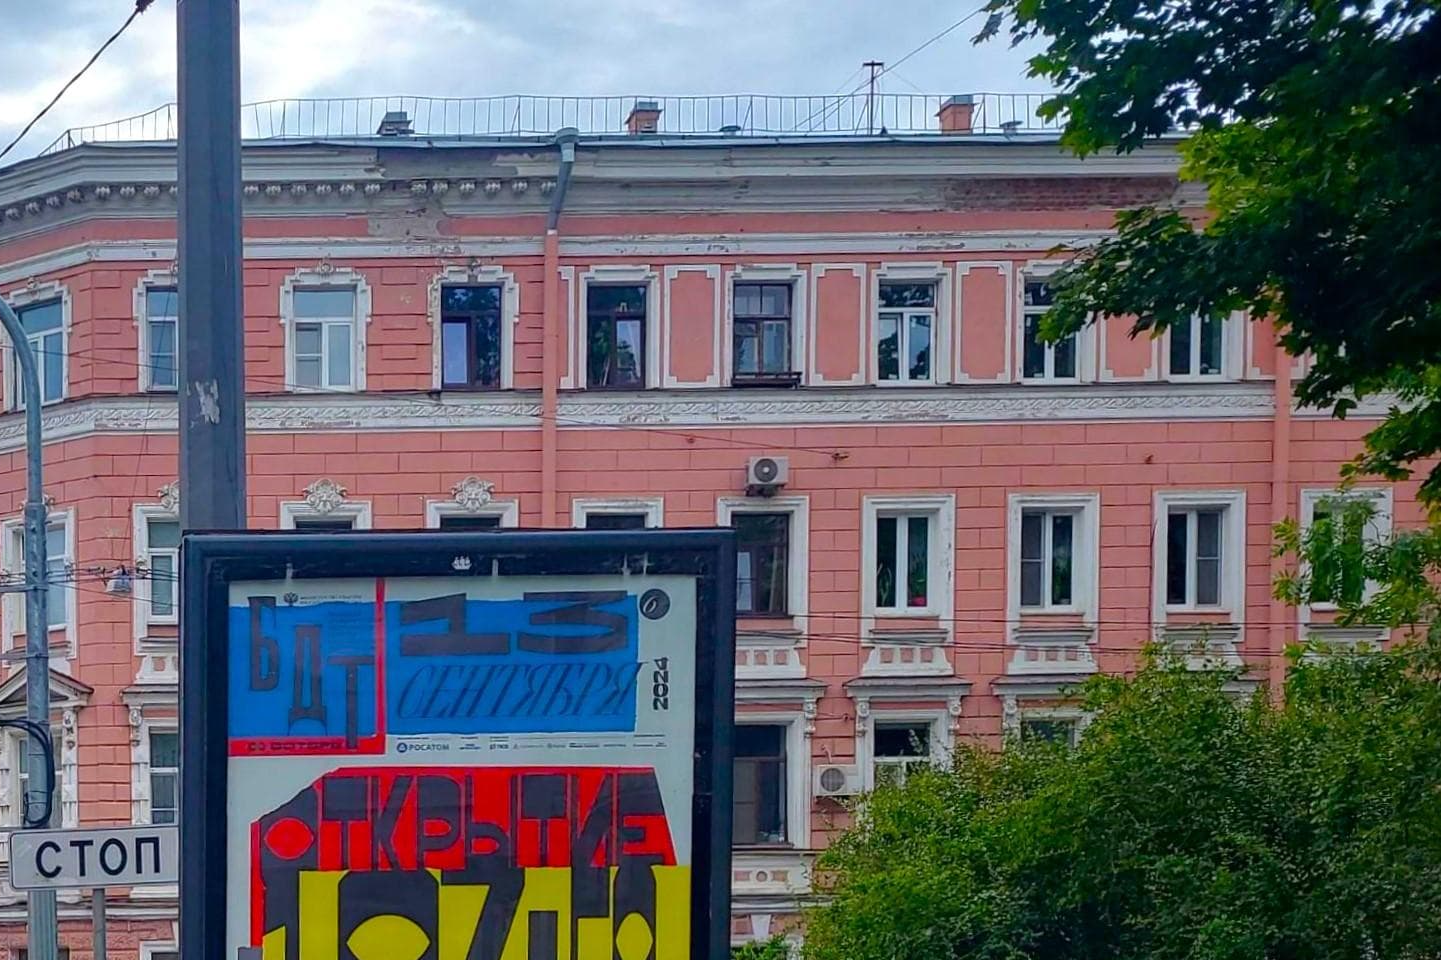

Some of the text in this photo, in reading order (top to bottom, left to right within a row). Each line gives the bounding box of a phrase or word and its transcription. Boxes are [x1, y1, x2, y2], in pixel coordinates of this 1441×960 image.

[399, 590, 628, 656] 13
[247, 596, 375, 749] БДТ
[397, 661, 648, 719] СЕНТЯБРЯ
[653, 657, 669, 710] 2024
[409, 743, 450, 751] РОСАТОМ
[260, 773, 668, 872] ОТКРЫТИЕ
[35, 836, 161, 879] СТОП
